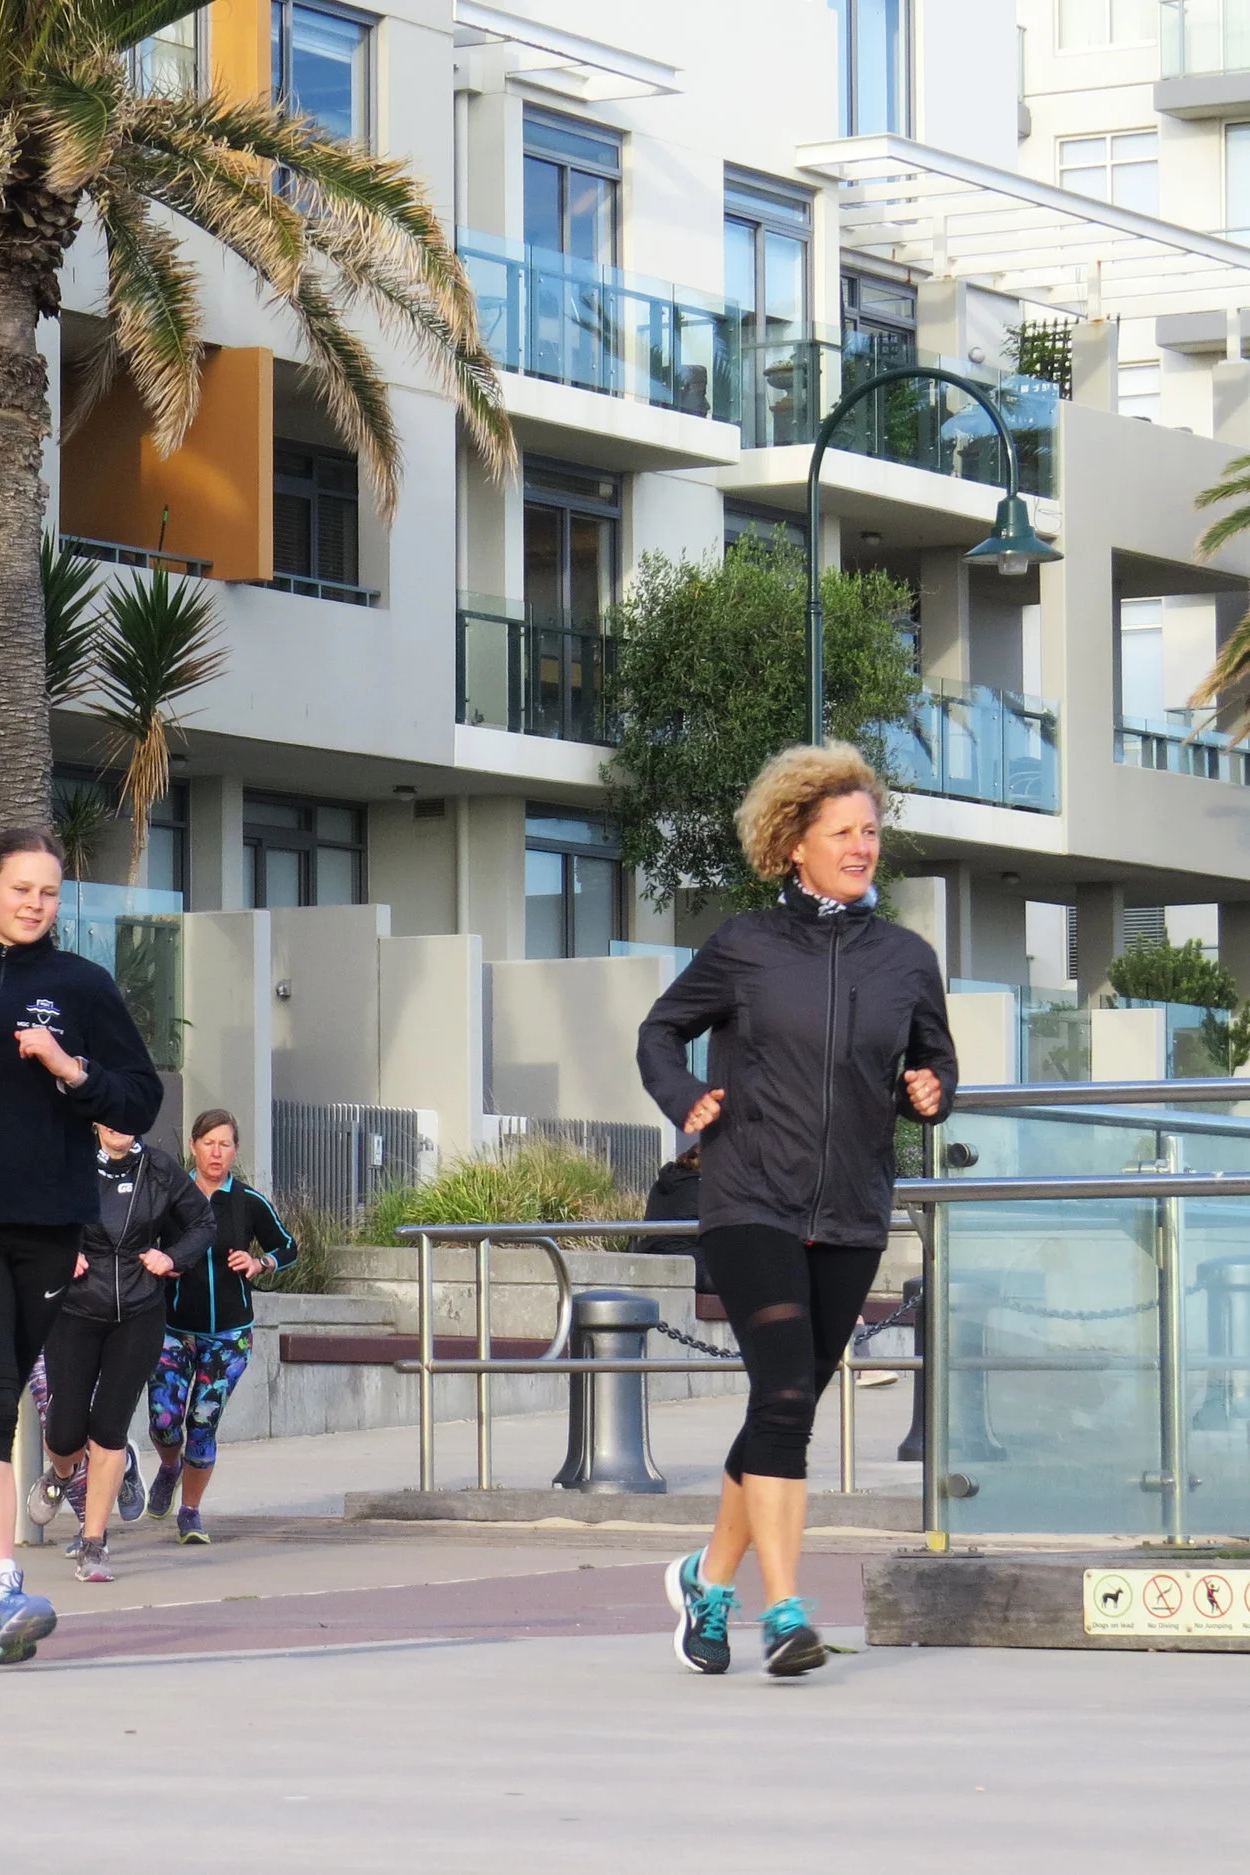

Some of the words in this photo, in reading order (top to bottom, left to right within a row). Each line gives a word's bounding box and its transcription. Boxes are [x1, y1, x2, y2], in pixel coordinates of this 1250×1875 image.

[1092, 1621, 1109, 1629] Dogs
[1120, 1621, 1134, 1629] lead
[1158, 1622, 1179, 1631] Diving
[1205, 1623, 1233, 1631] Jumping
